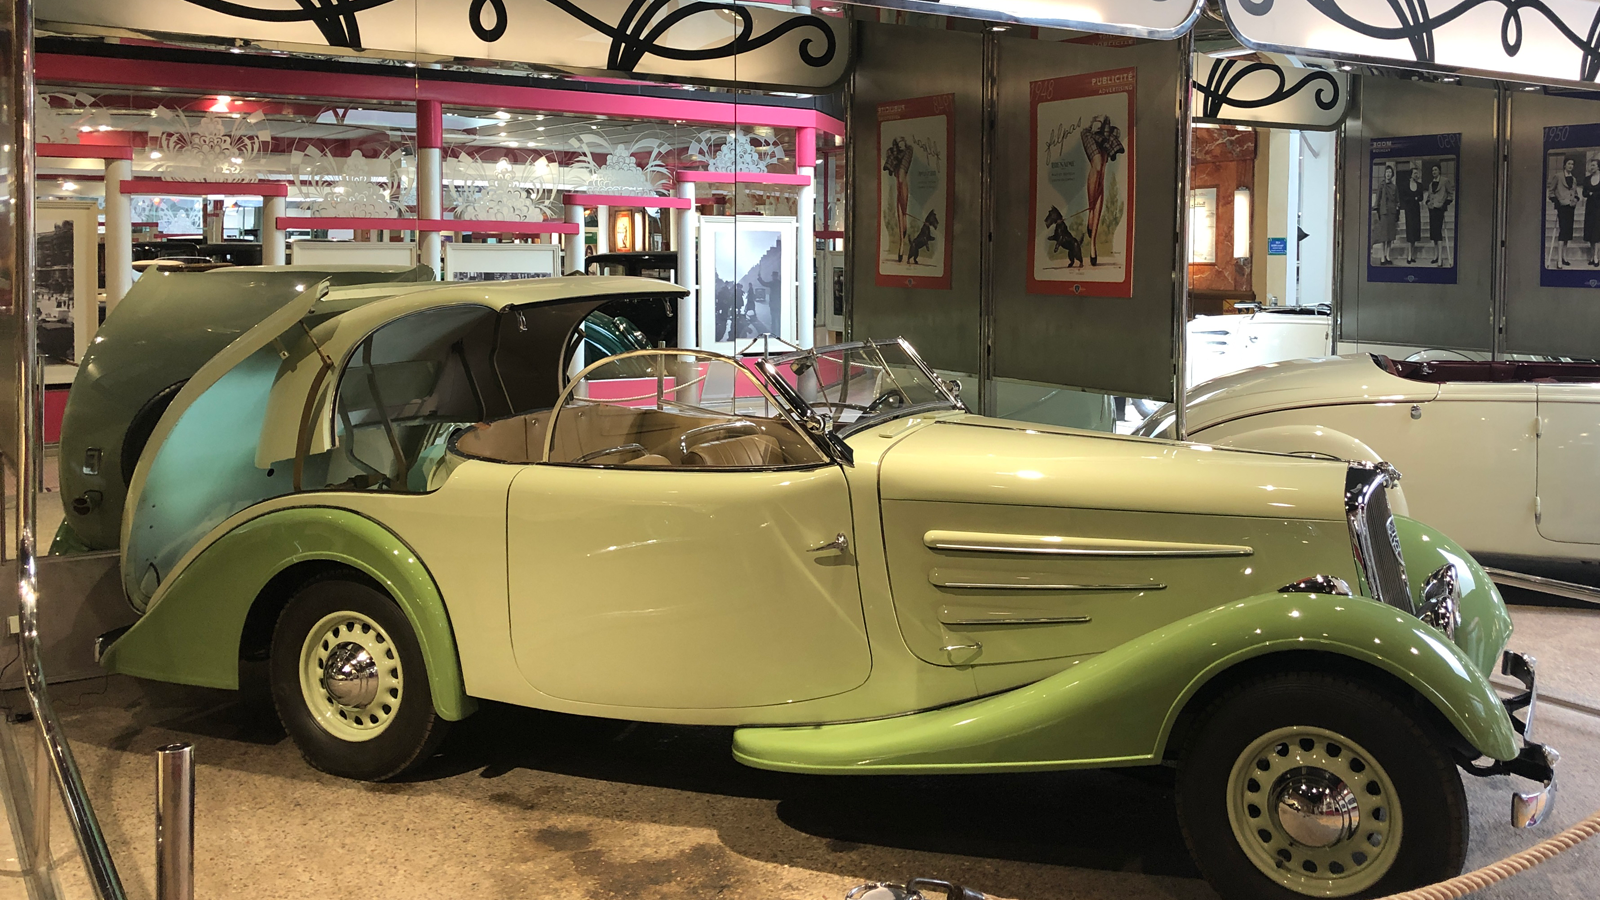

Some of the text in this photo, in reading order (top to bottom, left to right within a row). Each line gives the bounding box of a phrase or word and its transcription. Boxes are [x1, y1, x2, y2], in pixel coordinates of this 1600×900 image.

[1091, 71, 1133, 86] PUBLICITÉ
[1030, 80, 1055, 101] 1948
[1099, 86, 1133, 94] ADVERTISING
[1544, 126, 1569, 142] 1950
